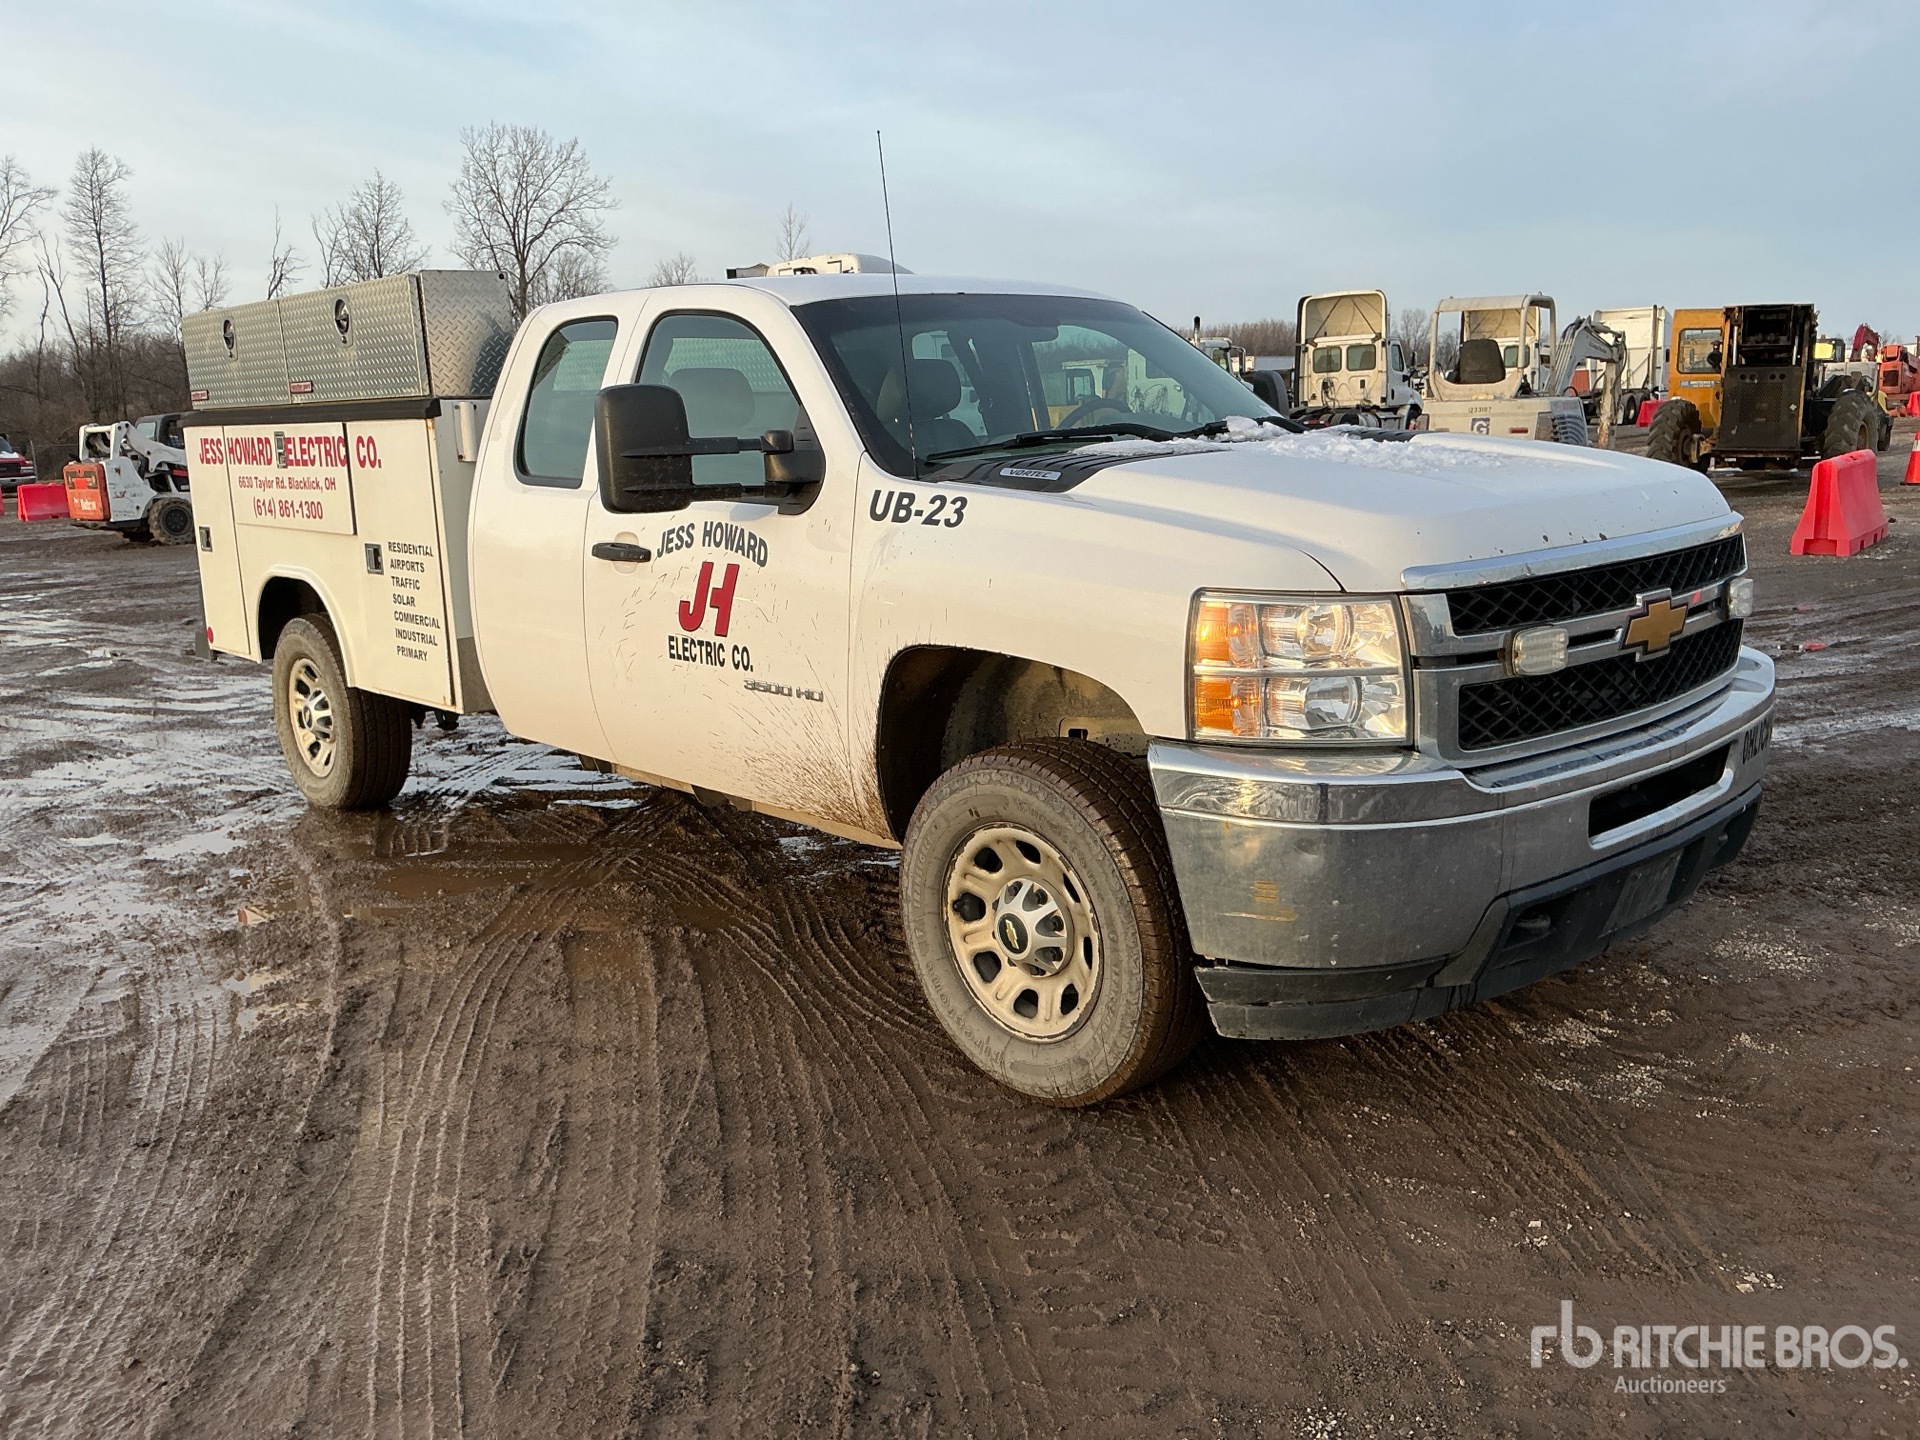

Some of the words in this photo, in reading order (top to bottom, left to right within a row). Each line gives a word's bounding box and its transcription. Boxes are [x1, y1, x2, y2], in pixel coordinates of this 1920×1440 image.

[199, 438, 224, 465] JESS
[227, 437, 272, 466] HOWARD
[285, 436, 348, 467] ELECTRIC
[356, 435, 382, 469] CO.
[1009, 469, 1050, 478] VORTEC
[239, 476, 253, 489] 6630
[254, 477, 274, 492] Taylor
[275, 477, 287, 490] Rd.
[288, 477, 323, 493] Blacklick,
[324, 478, 336, 490] OH
[253, 496, 276, 519] (614)
[278, 500, 323, 519] 861-1300
[869, 489, 967, 528] UB-23
[388, 541, 434, 557] RESIDENTIAL
[656, 522, 695, 558] JESS
[702, 520, 768, 567] HOWARD
[390, 558, 425, 573] AIRPORTS
[391, 576, 420, 590] TRAFFIC
[392, 593, 416, 607] SOLAR
[394, 610, 441, 629] COMMERCIAL
[395, 627, 438, 646] INDUSTRIAL
[396, 645, 428, 661] PRIMARY
[668, 634, 726, 667] ELECTRIC
[731, 645, 753, 672] CO.
